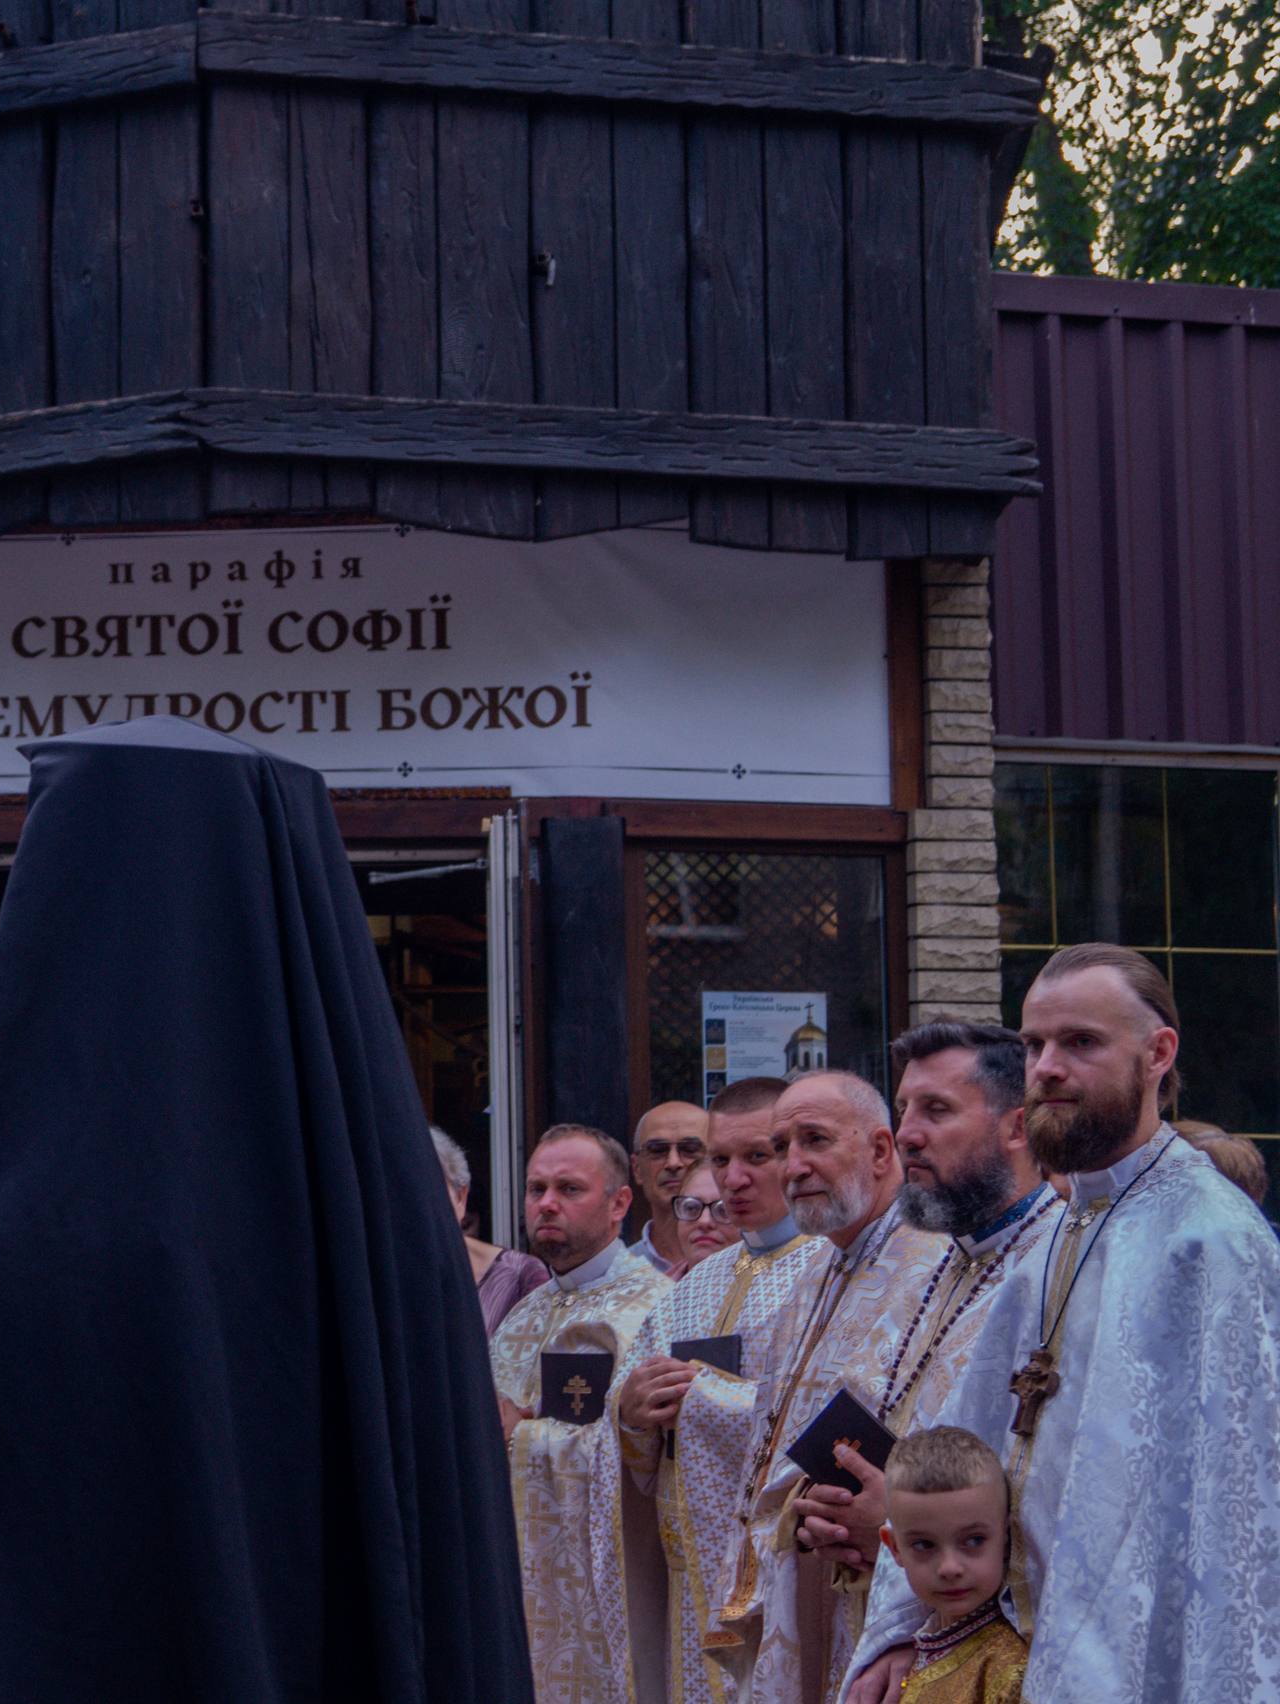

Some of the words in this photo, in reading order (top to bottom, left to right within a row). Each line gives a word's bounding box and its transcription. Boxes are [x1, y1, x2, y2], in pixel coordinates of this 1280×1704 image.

[108, 549, 364, 591] парафія
[10, 598, 245, 660] СВЯТОЇ
[267, 593, 453, 653] СОФІЇ
[376, 671, 592, 732] БОЖОЇ
